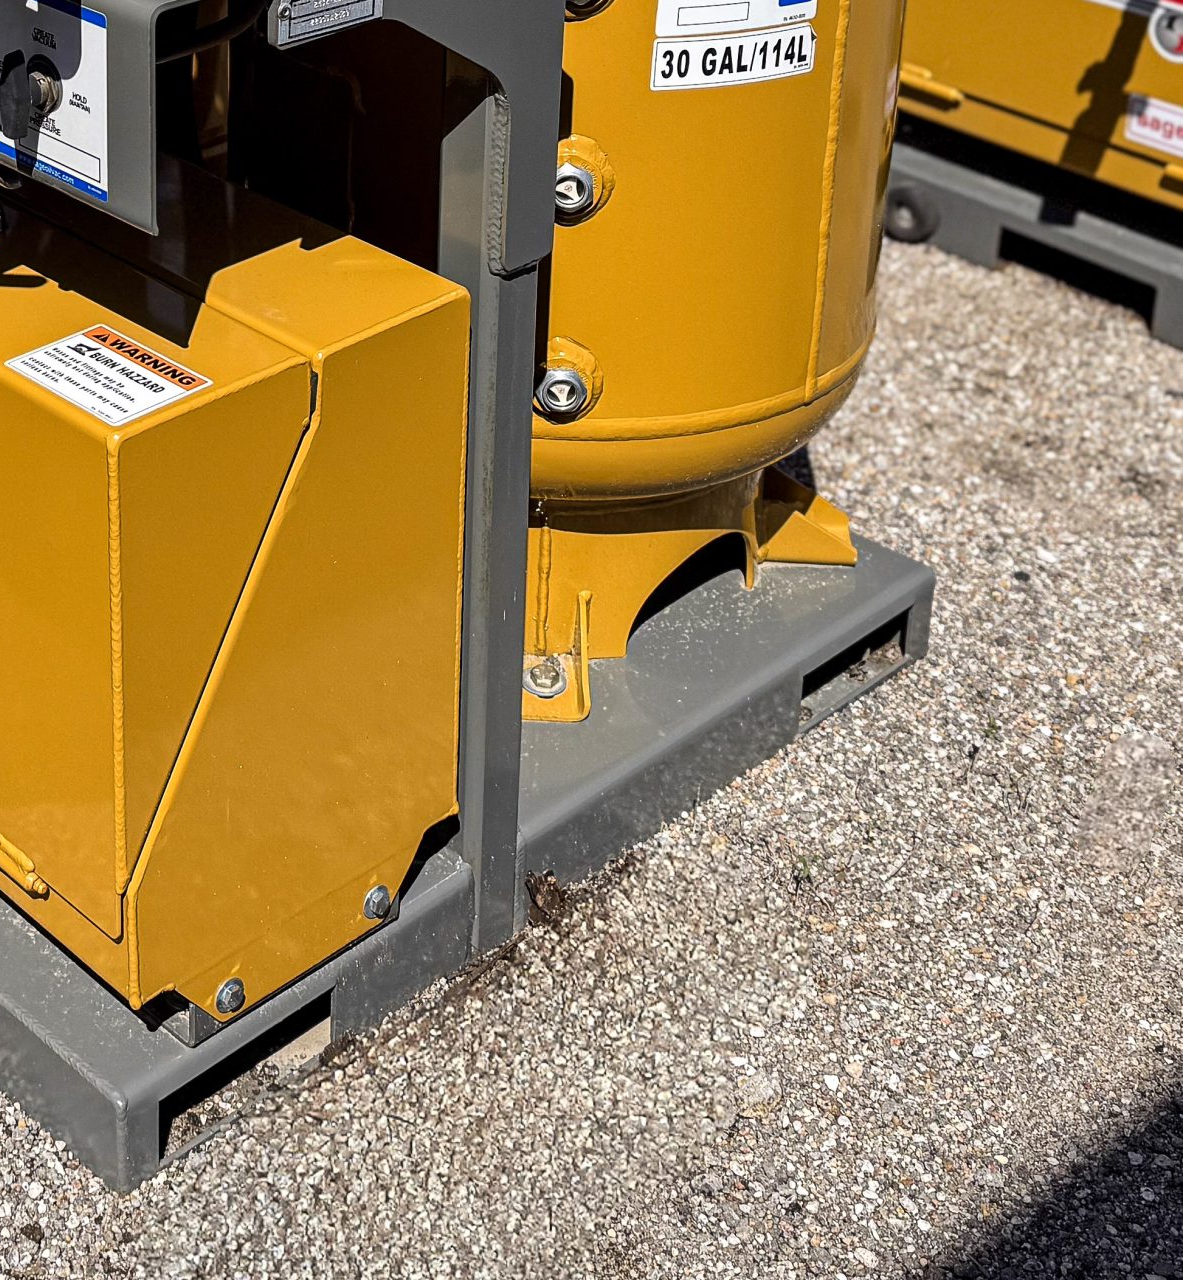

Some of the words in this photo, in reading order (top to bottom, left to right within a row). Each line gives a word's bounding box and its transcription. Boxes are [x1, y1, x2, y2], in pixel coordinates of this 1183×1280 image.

[660, 48, 690, 80] 30
[701, 34, 808, 77] GAL/114L
[72, 91, 88, 105] HOLD
[89, 351, 119, 369] BURN
[116, 366, 164, 393] HAZZARD
[108, 338, 196, 386] WARNING
